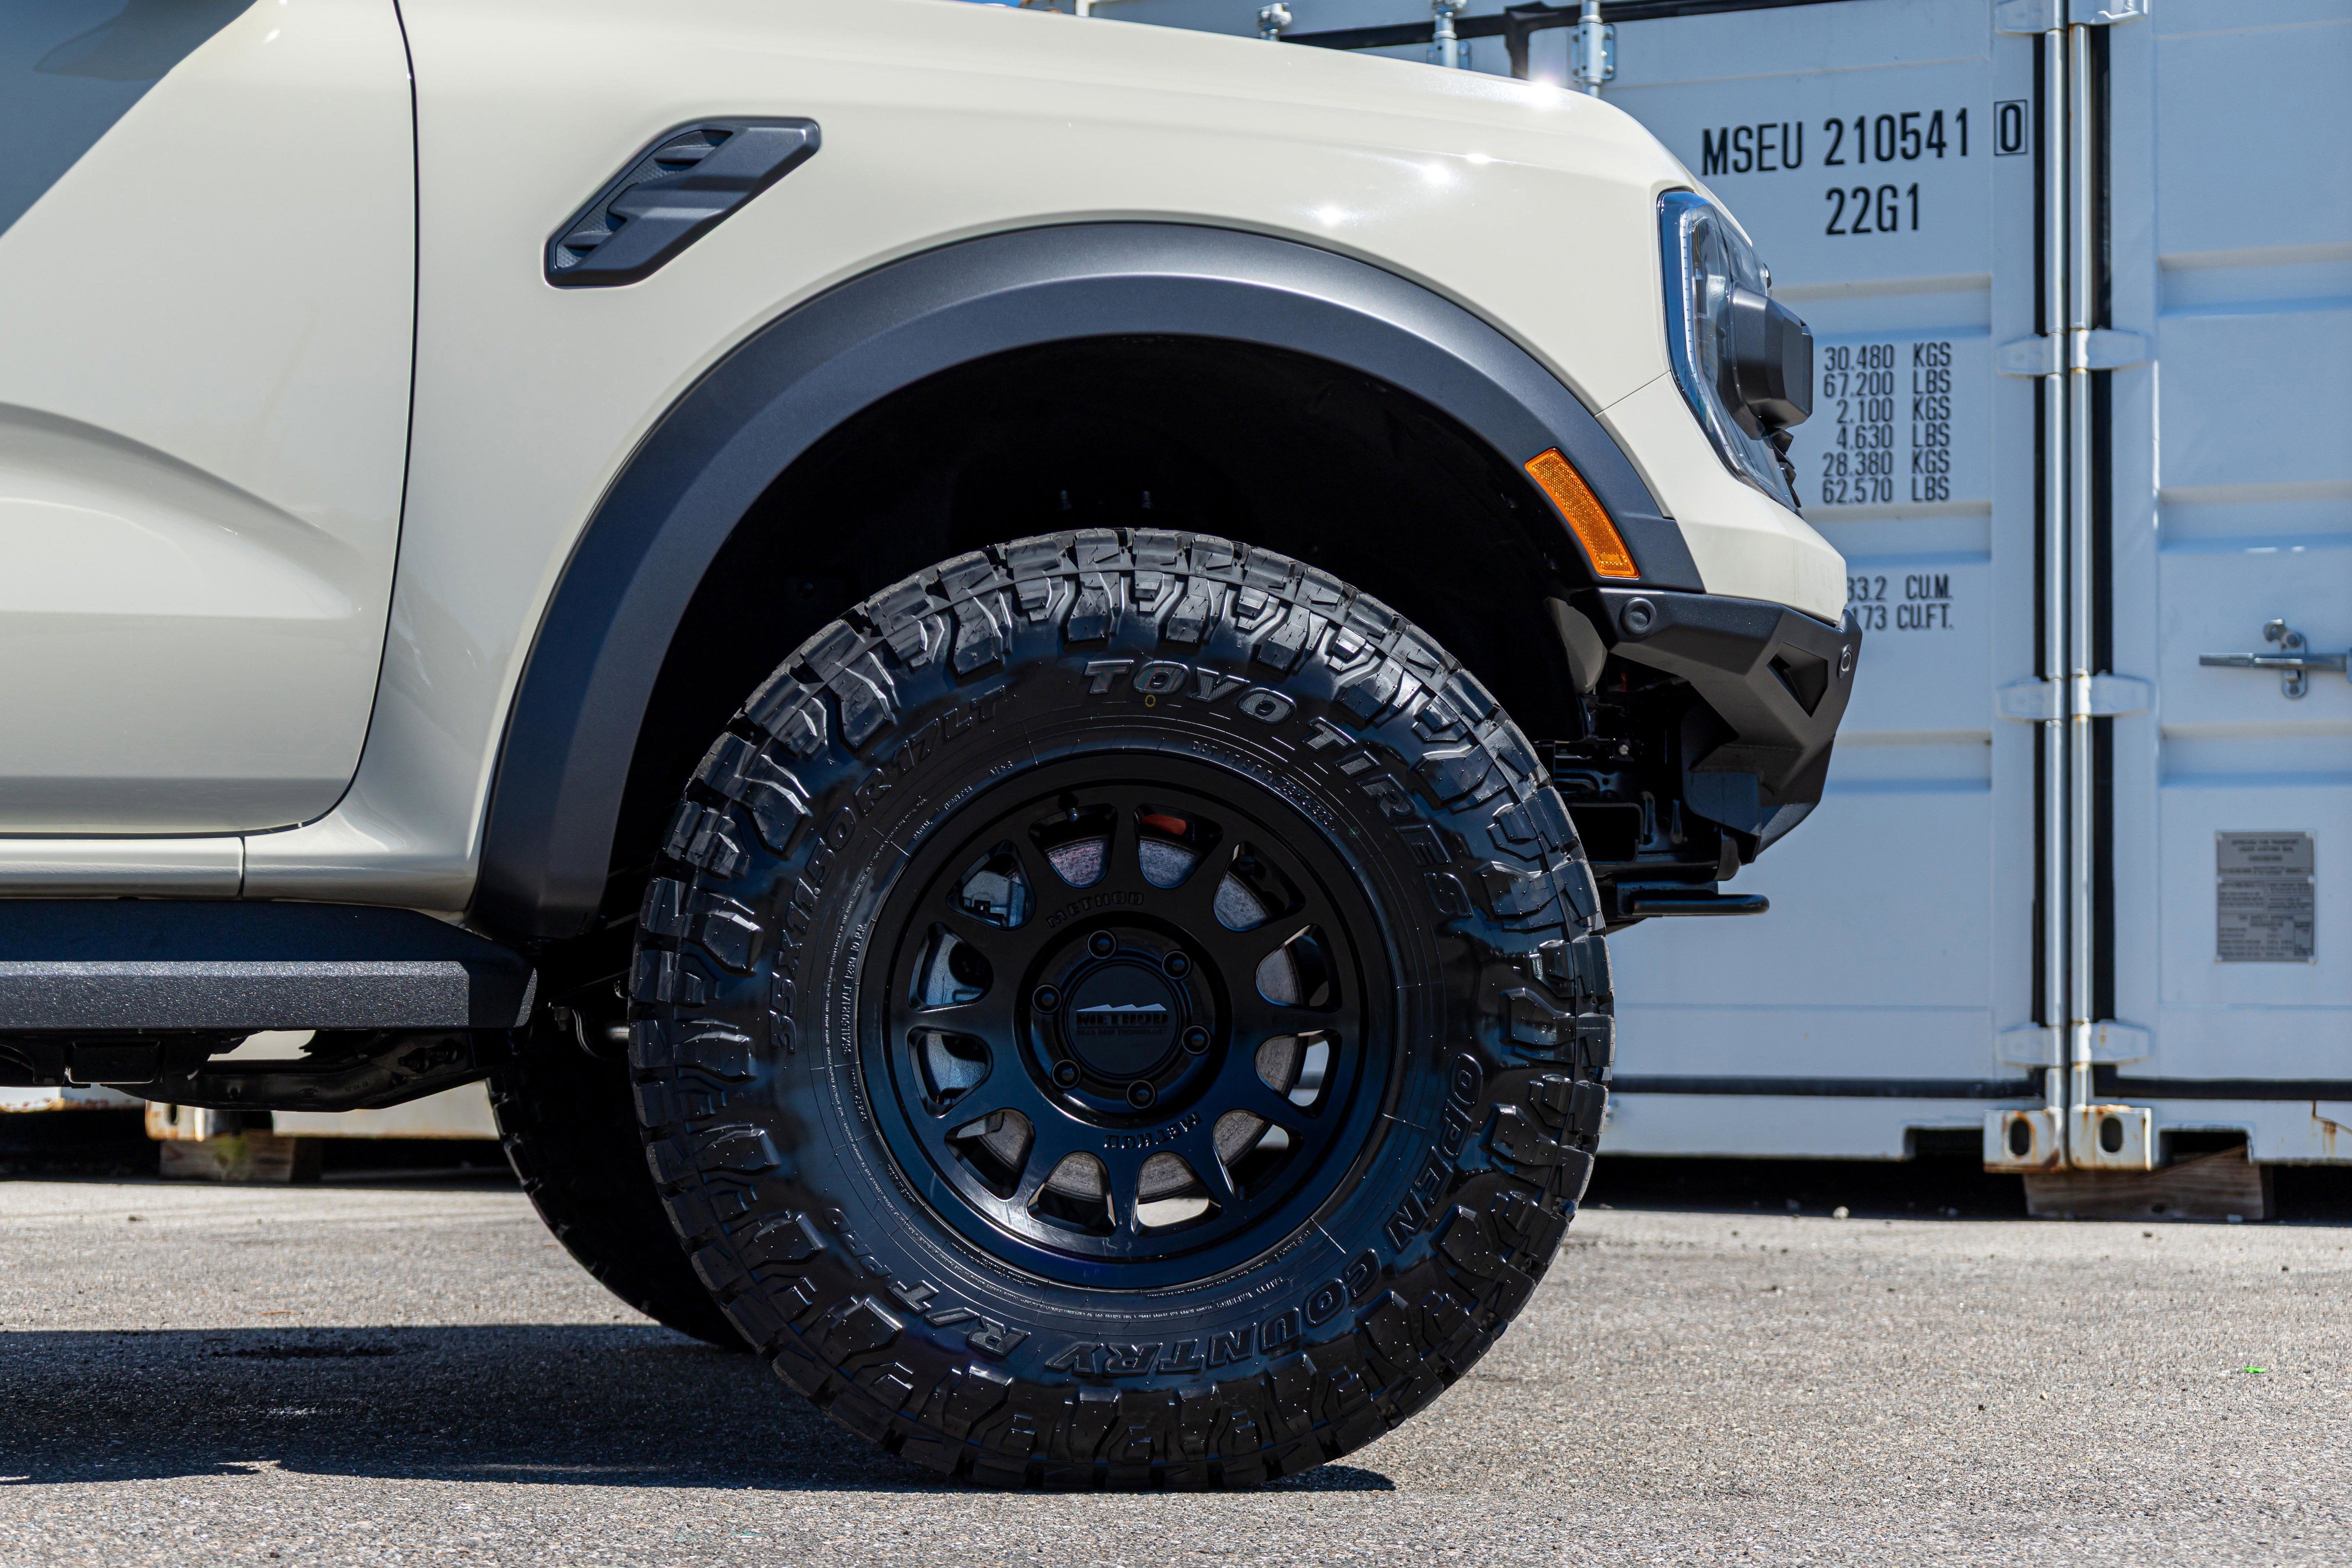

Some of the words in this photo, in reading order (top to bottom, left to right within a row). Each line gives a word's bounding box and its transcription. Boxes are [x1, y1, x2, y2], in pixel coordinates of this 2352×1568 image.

[1702, 121, 1802, 176] MSEU
[1824, 107, 1968, 166] 210541
[1826, 182, 1919, 236] 22G1
[1824, 344, 1894, 371] 30.480
[1913, 341, 1951, 368] KGS
[1824, 370, 1893, 398] 67.200
[1913, 369, 1951, 394] LBS
[1836, 397, 1893, 424] 2.100
[1912, 396, 1950, 421] KGS
[1836, 423, 1893, 450] 4.630
[1912, 422, 1950, 448] LBS
[1822, 450, 1893, 477] 28.380
[1912, 449, 1950, 474] KGS
[1822, 477, 1892, 503] 62.570
[1911, 475, 1949, 501] LBS
[1085, 659, 1294, 726] TOYO
[1303, 718, 1473, 918] TIRES
[1046, 891, 1143, 928] METHOD
[1076, 1012, 1168, 1026] METHOD
[1104, 1111, 1202, 1149] METHOD
[1385, 1053, 1481, 1253] OPEN
[824, 1206, 893, 1279] PRO
[888, 1278, 1031, 1358] R/T
[1047, 1247, 1383, 1376] COUNTRY
